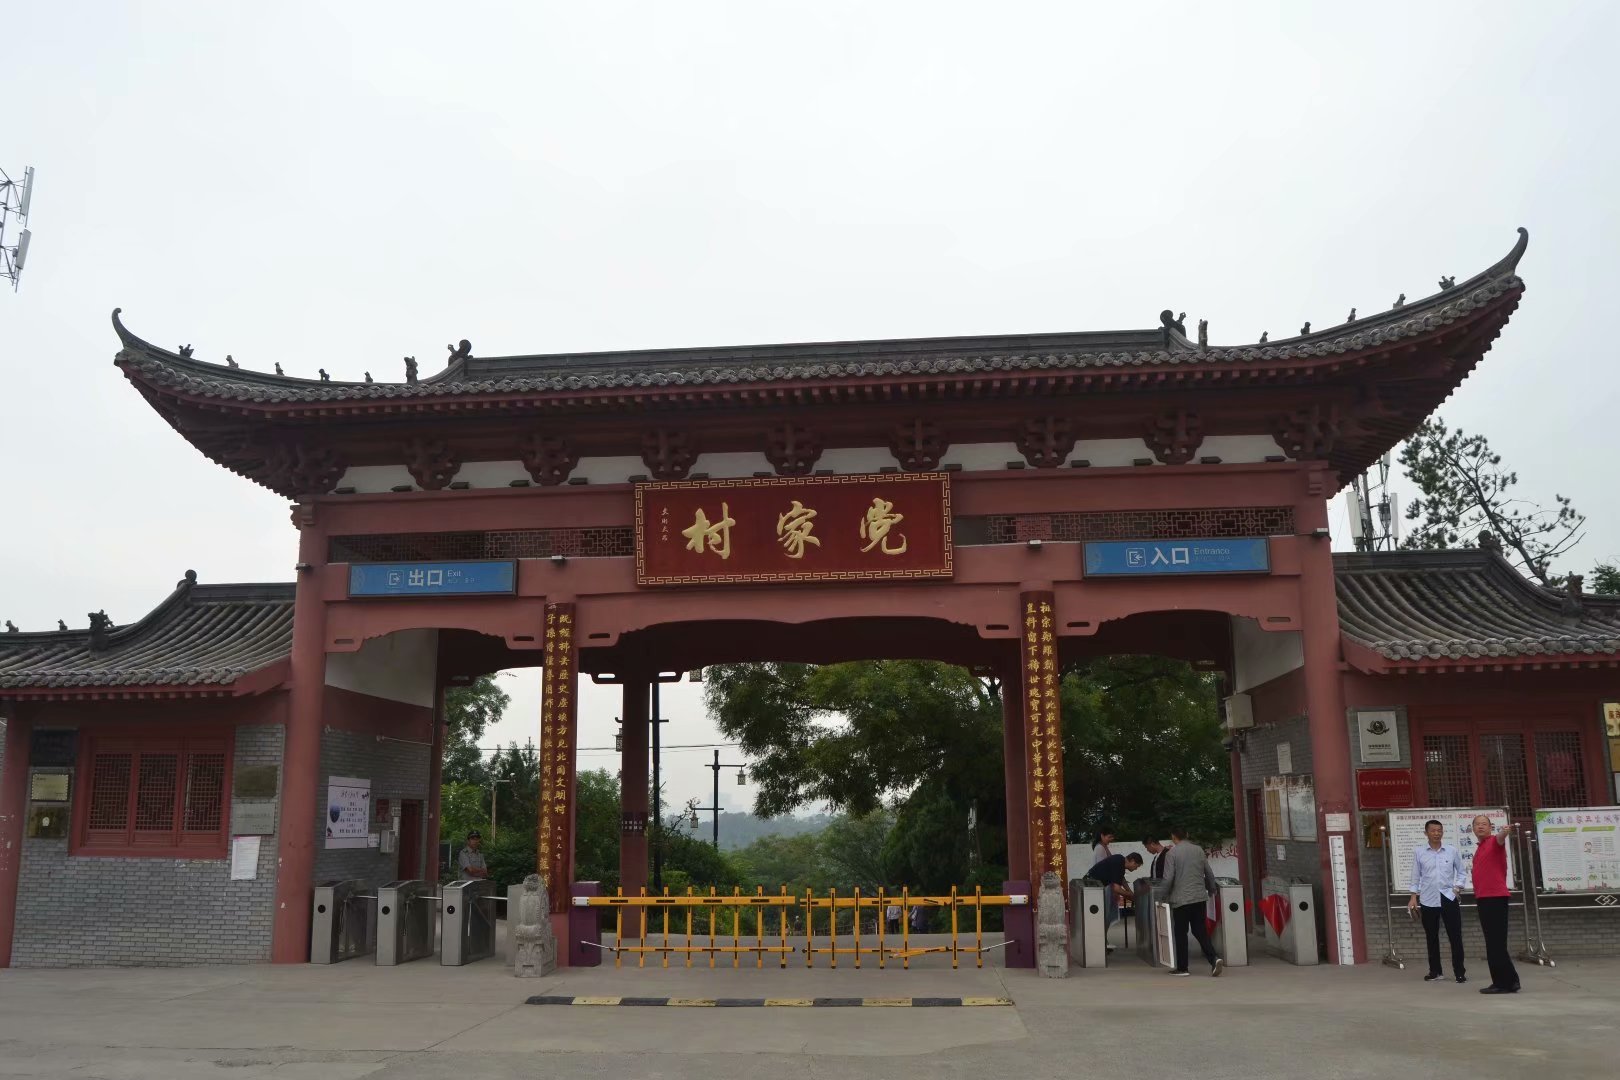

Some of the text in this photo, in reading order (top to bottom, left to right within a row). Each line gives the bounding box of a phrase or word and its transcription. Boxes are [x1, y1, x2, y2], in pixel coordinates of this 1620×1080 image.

[682, 497, 907, 559] 党家村
[1150, 547, 1190, 565] 入口
[1193, 547, 1230, 555] Entrance
[408, 568, 443, 586] 出口
[447, 569, 461, 577] Exit
